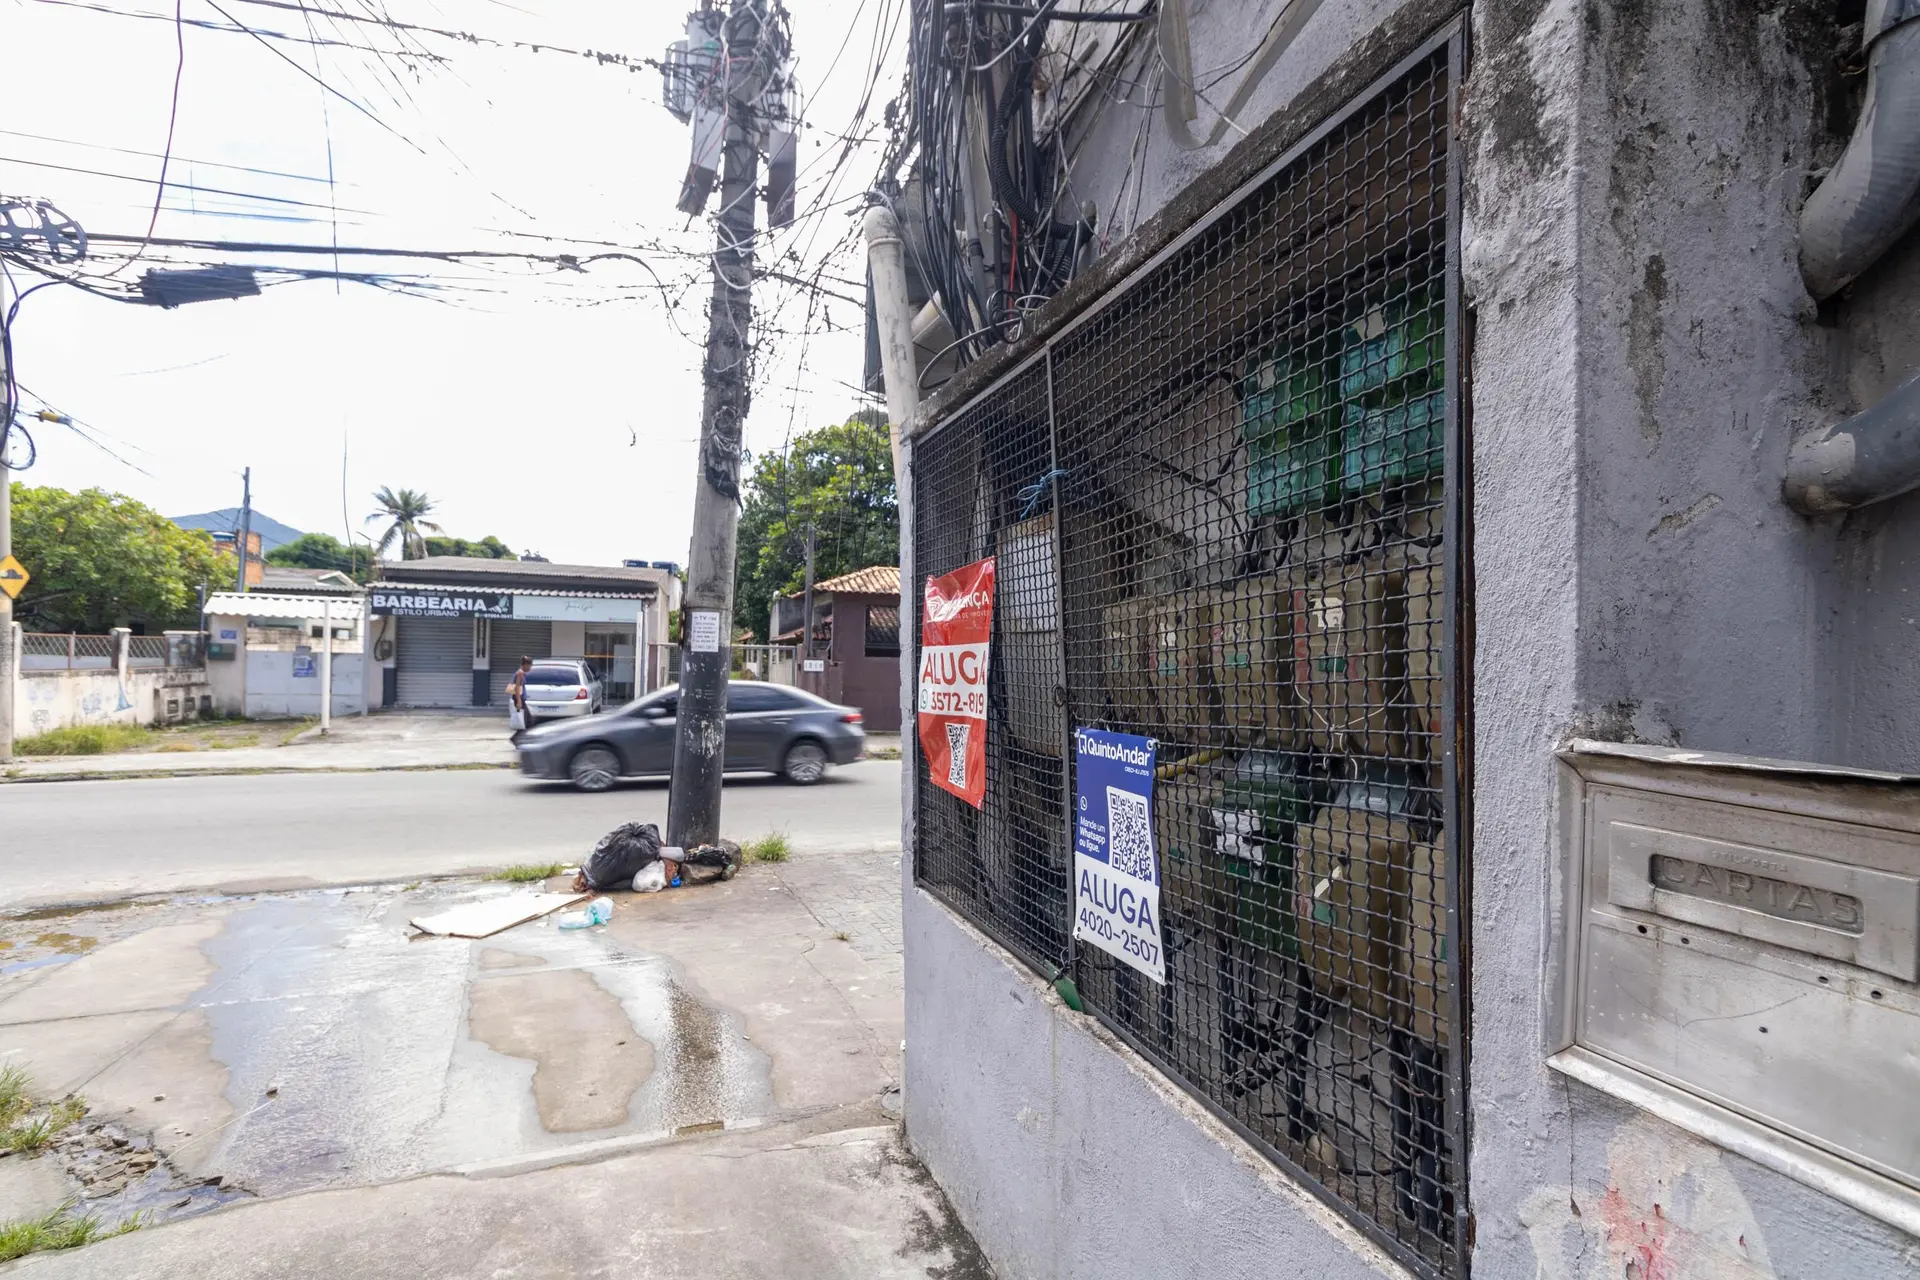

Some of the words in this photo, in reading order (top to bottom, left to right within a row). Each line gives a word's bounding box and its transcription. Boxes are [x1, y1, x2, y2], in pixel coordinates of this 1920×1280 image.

[372, 594, 487, 611] BARBEARIA
[392, 608, 422, 616] ESTILO
[424, 609, 460, 617] URBANO
[922, 650, 986, 686] ALUGA
[1087, 737, 1151, 767] QuintoAndar
[1080, 816, 1097, 831] Mande
[1097, 824, 1106, 833] um
[1079, 839, 1086, 847] ou
[1080, 869, 1157, 936] ALUGA
[1660, 857, 1860, 926] CARTAS
[1080, 907, 1159, 966] 4020-2507
